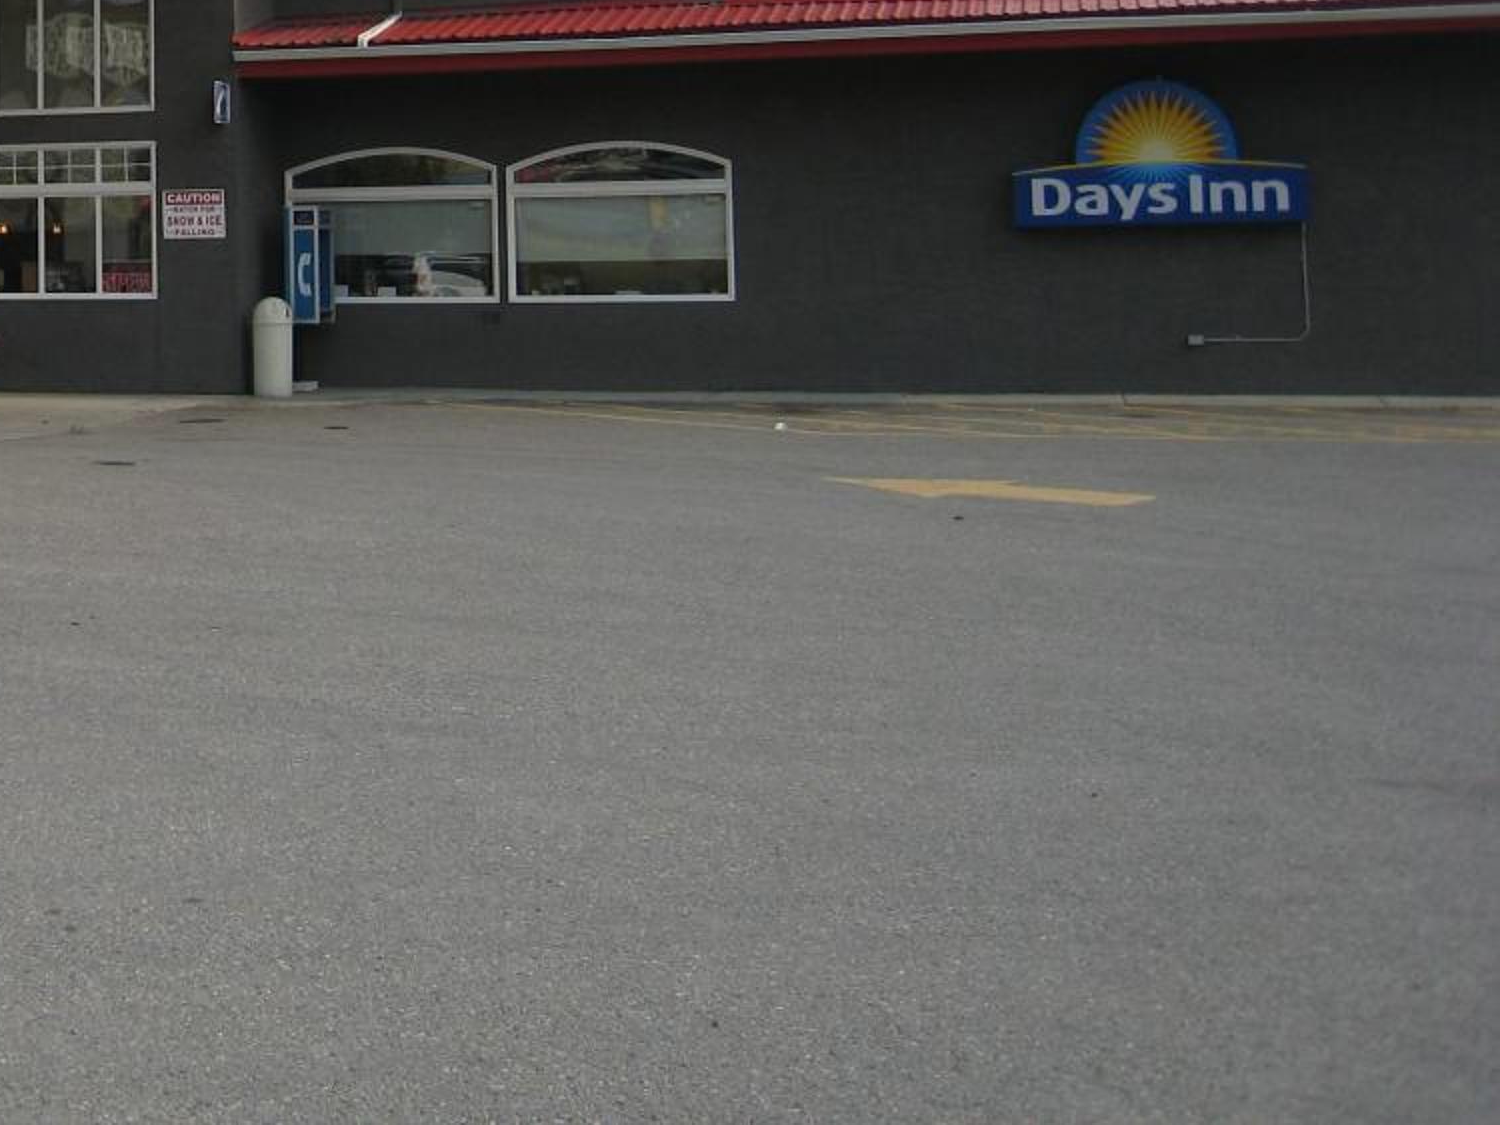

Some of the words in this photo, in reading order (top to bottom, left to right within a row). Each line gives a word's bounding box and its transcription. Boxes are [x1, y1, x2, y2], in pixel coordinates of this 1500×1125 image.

[167, 193, 220, 204] CAUTION
[1031, 178, 1178, 221] Days
[1188, 174, 1290, 214] Inn
[167, 216, 195, 227] SNOW
[205, 215, 222, 225] ICE
